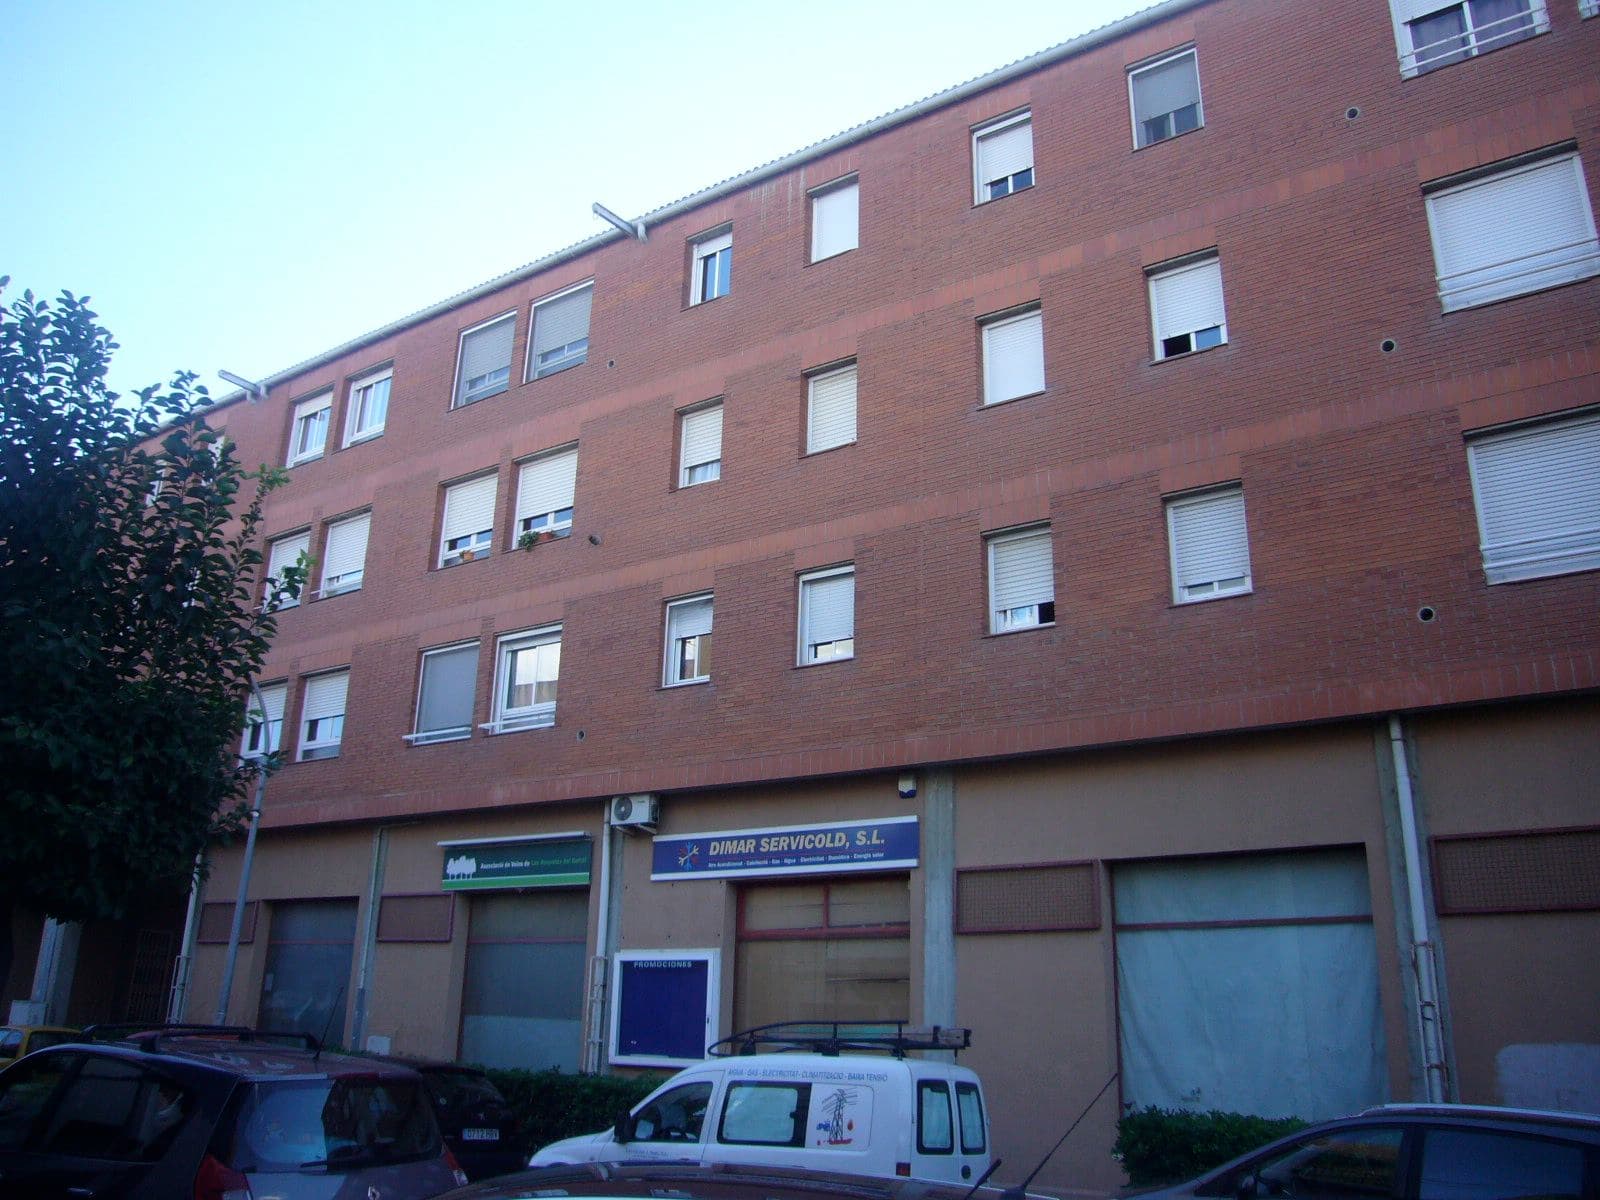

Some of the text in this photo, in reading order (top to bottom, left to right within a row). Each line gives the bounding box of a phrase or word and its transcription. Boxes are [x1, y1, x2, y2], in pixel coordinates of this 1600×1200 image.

[708, 829, 885, 856] DIMAR SERVICOLD, S.L.
[633, 960, 692, 969] PROMOCIONES
